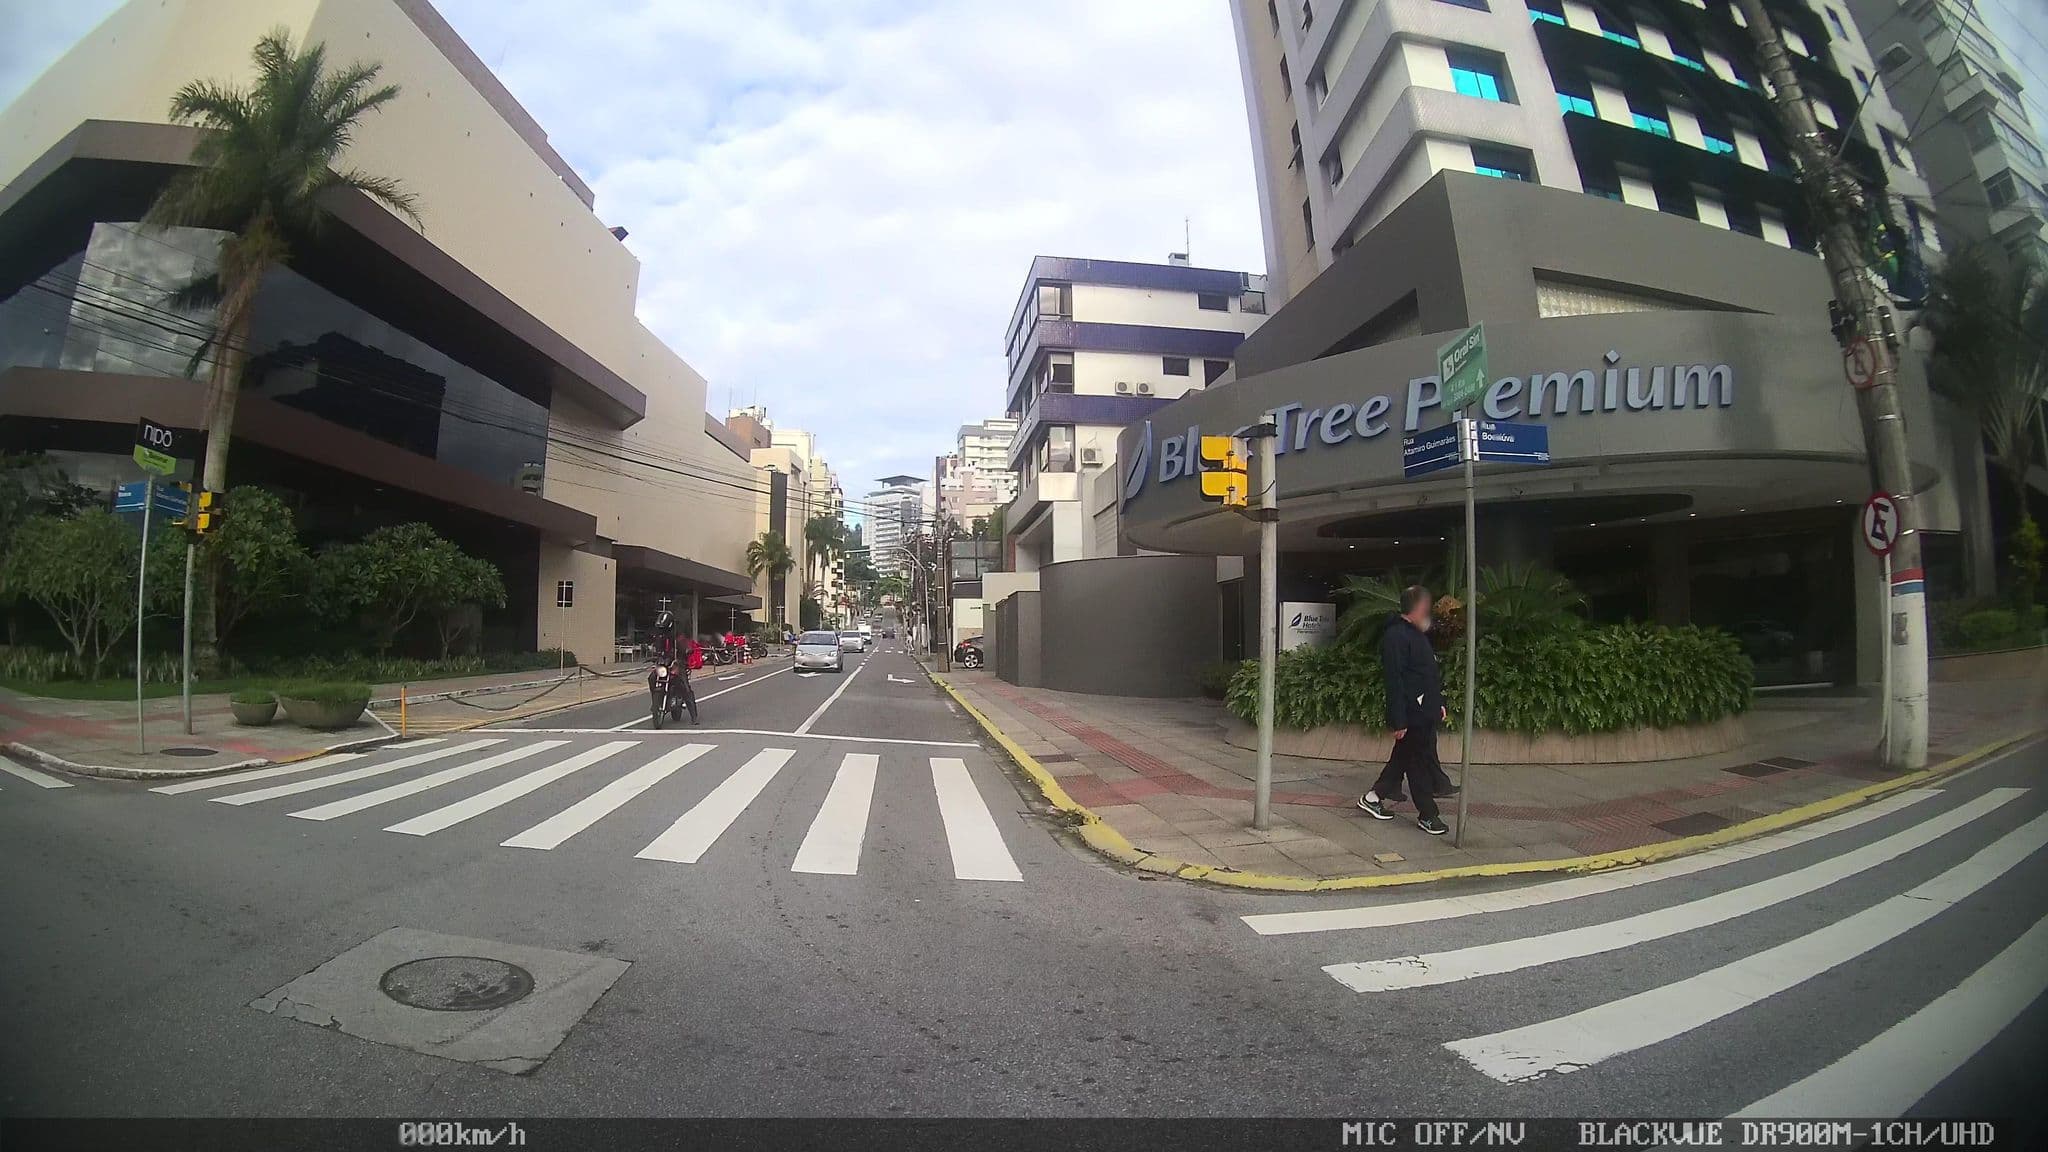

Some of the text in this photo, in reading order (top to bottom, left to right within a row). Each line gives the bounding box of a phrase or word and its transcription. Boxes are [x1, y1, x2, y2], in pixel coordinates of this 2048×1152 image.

[1454, 340, 1469, 362] Oral
[1159, 349, 1734, 484] Bl Tree Pemium
[1480, 421, 1496, 430] Rua
[1403, 438, 1415, 446] Rua
[1482, 432, 1515, 442] Boúva
